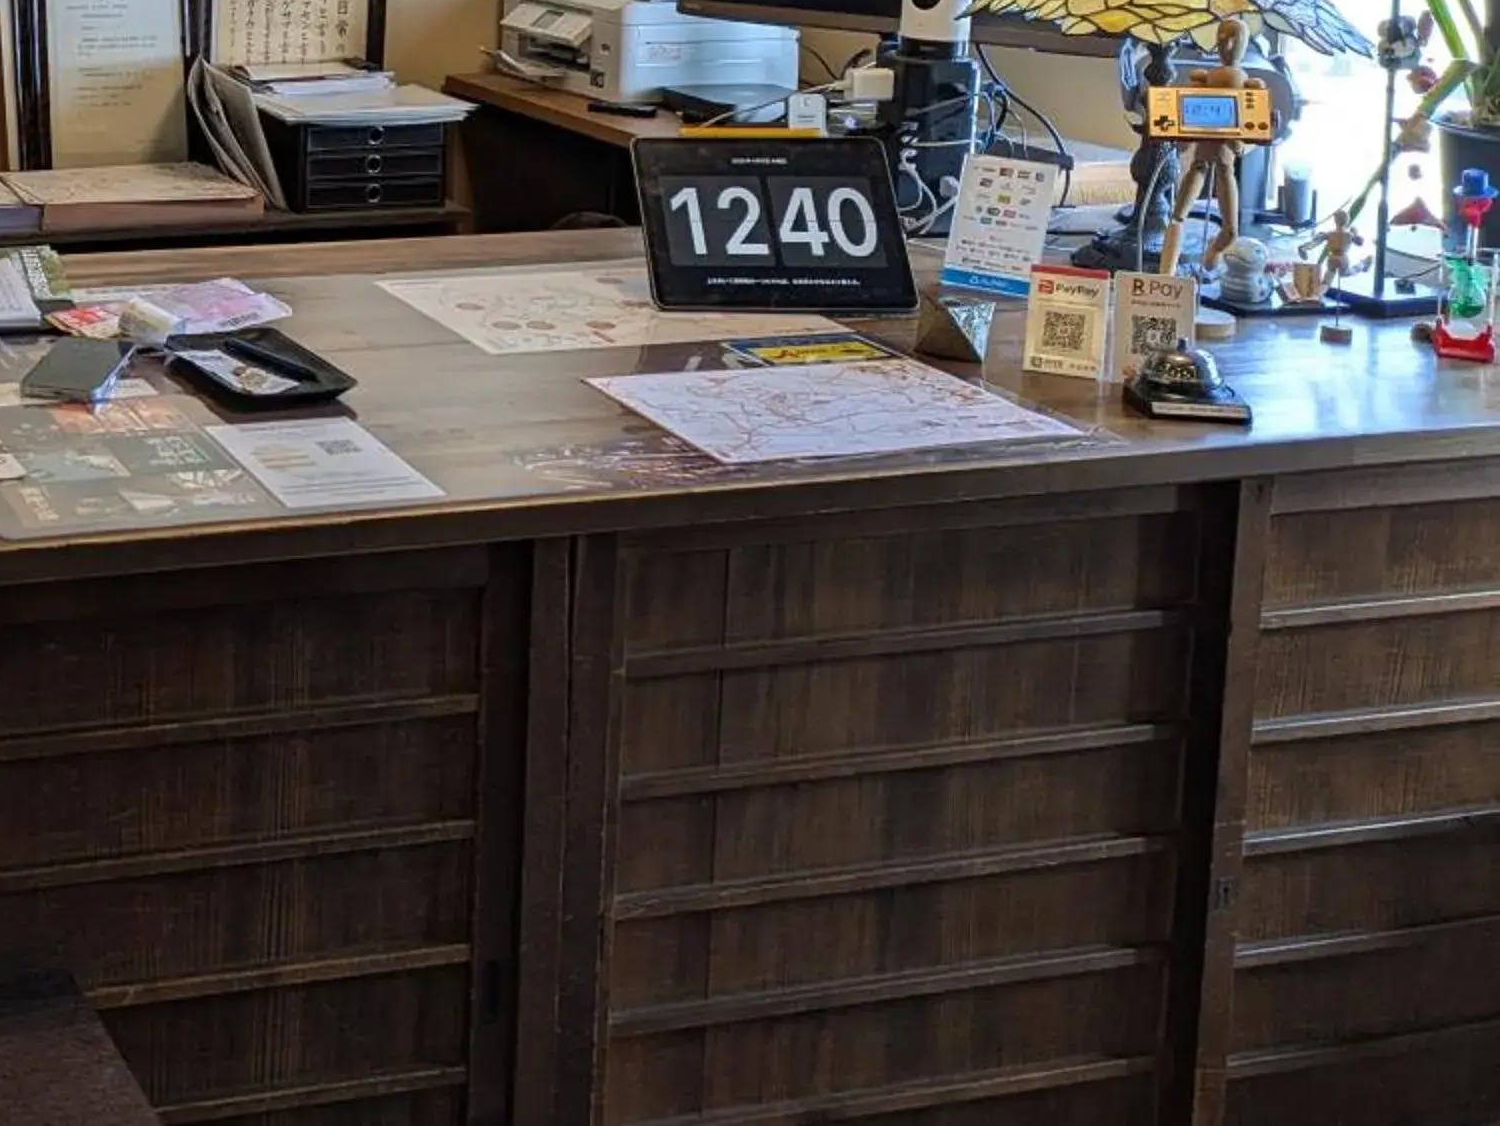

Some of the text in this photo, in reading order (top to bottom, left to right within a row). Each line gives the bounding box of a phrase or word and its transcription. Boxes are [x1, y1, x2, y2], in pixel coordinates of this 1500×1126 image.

[670, 186, 769, 255] 12
[779, 187, 877, 257] 40
[1055, 282, 1100, 299] PayPay
